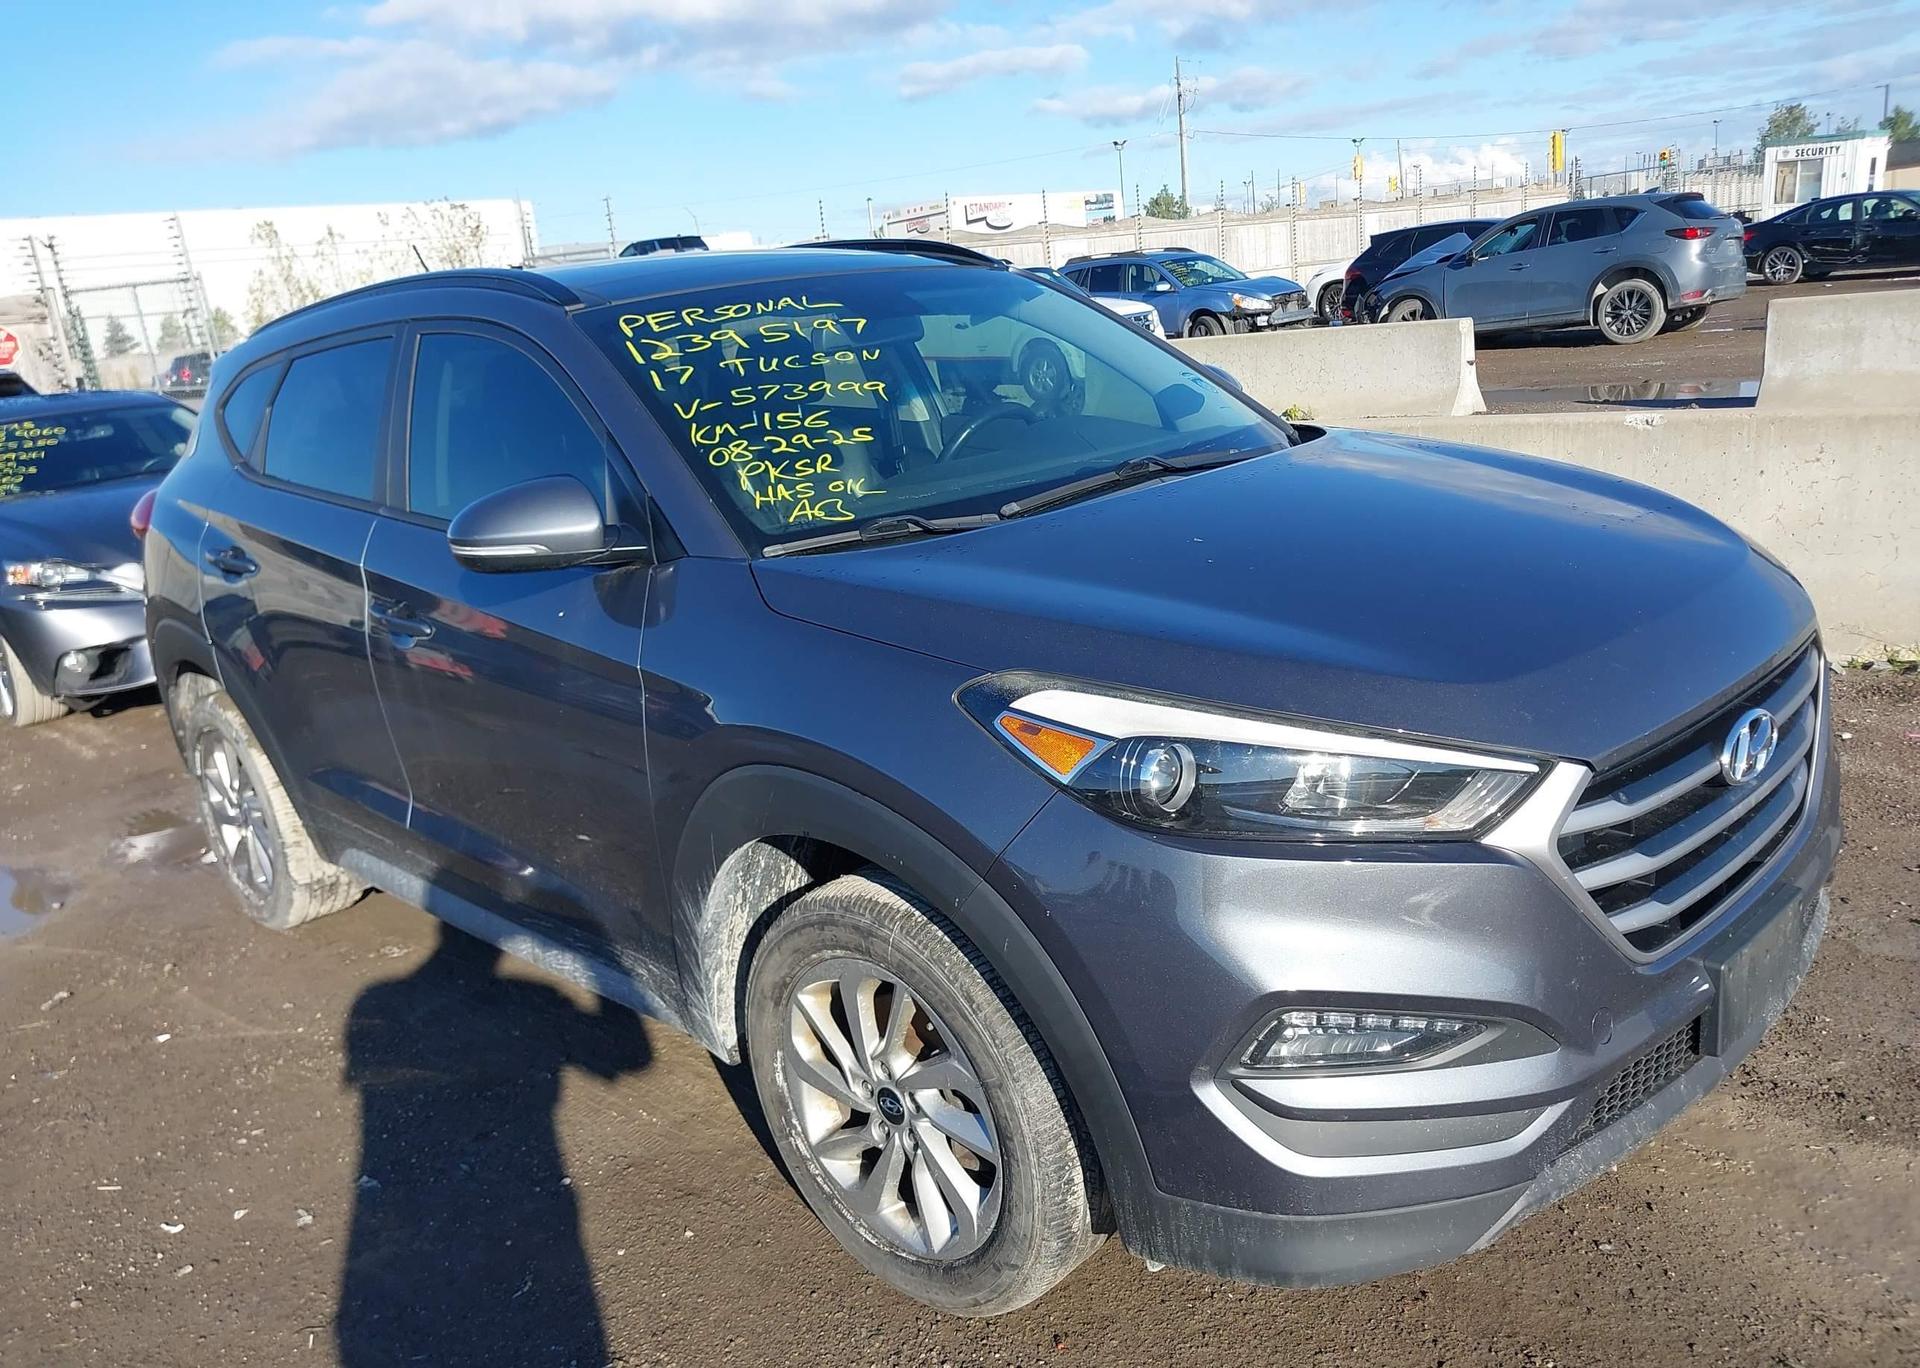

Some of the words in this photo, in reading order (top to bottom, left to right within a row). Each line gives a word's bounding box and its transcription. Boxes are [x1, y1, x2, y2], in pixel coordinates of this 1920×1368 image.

[1794, 145, 1841, 158] SECURITY
[619, 295, 844, 338] PERSONAL
[650, 365, 695, 392] 17
[719, 349, 881, 377] TUCSON
